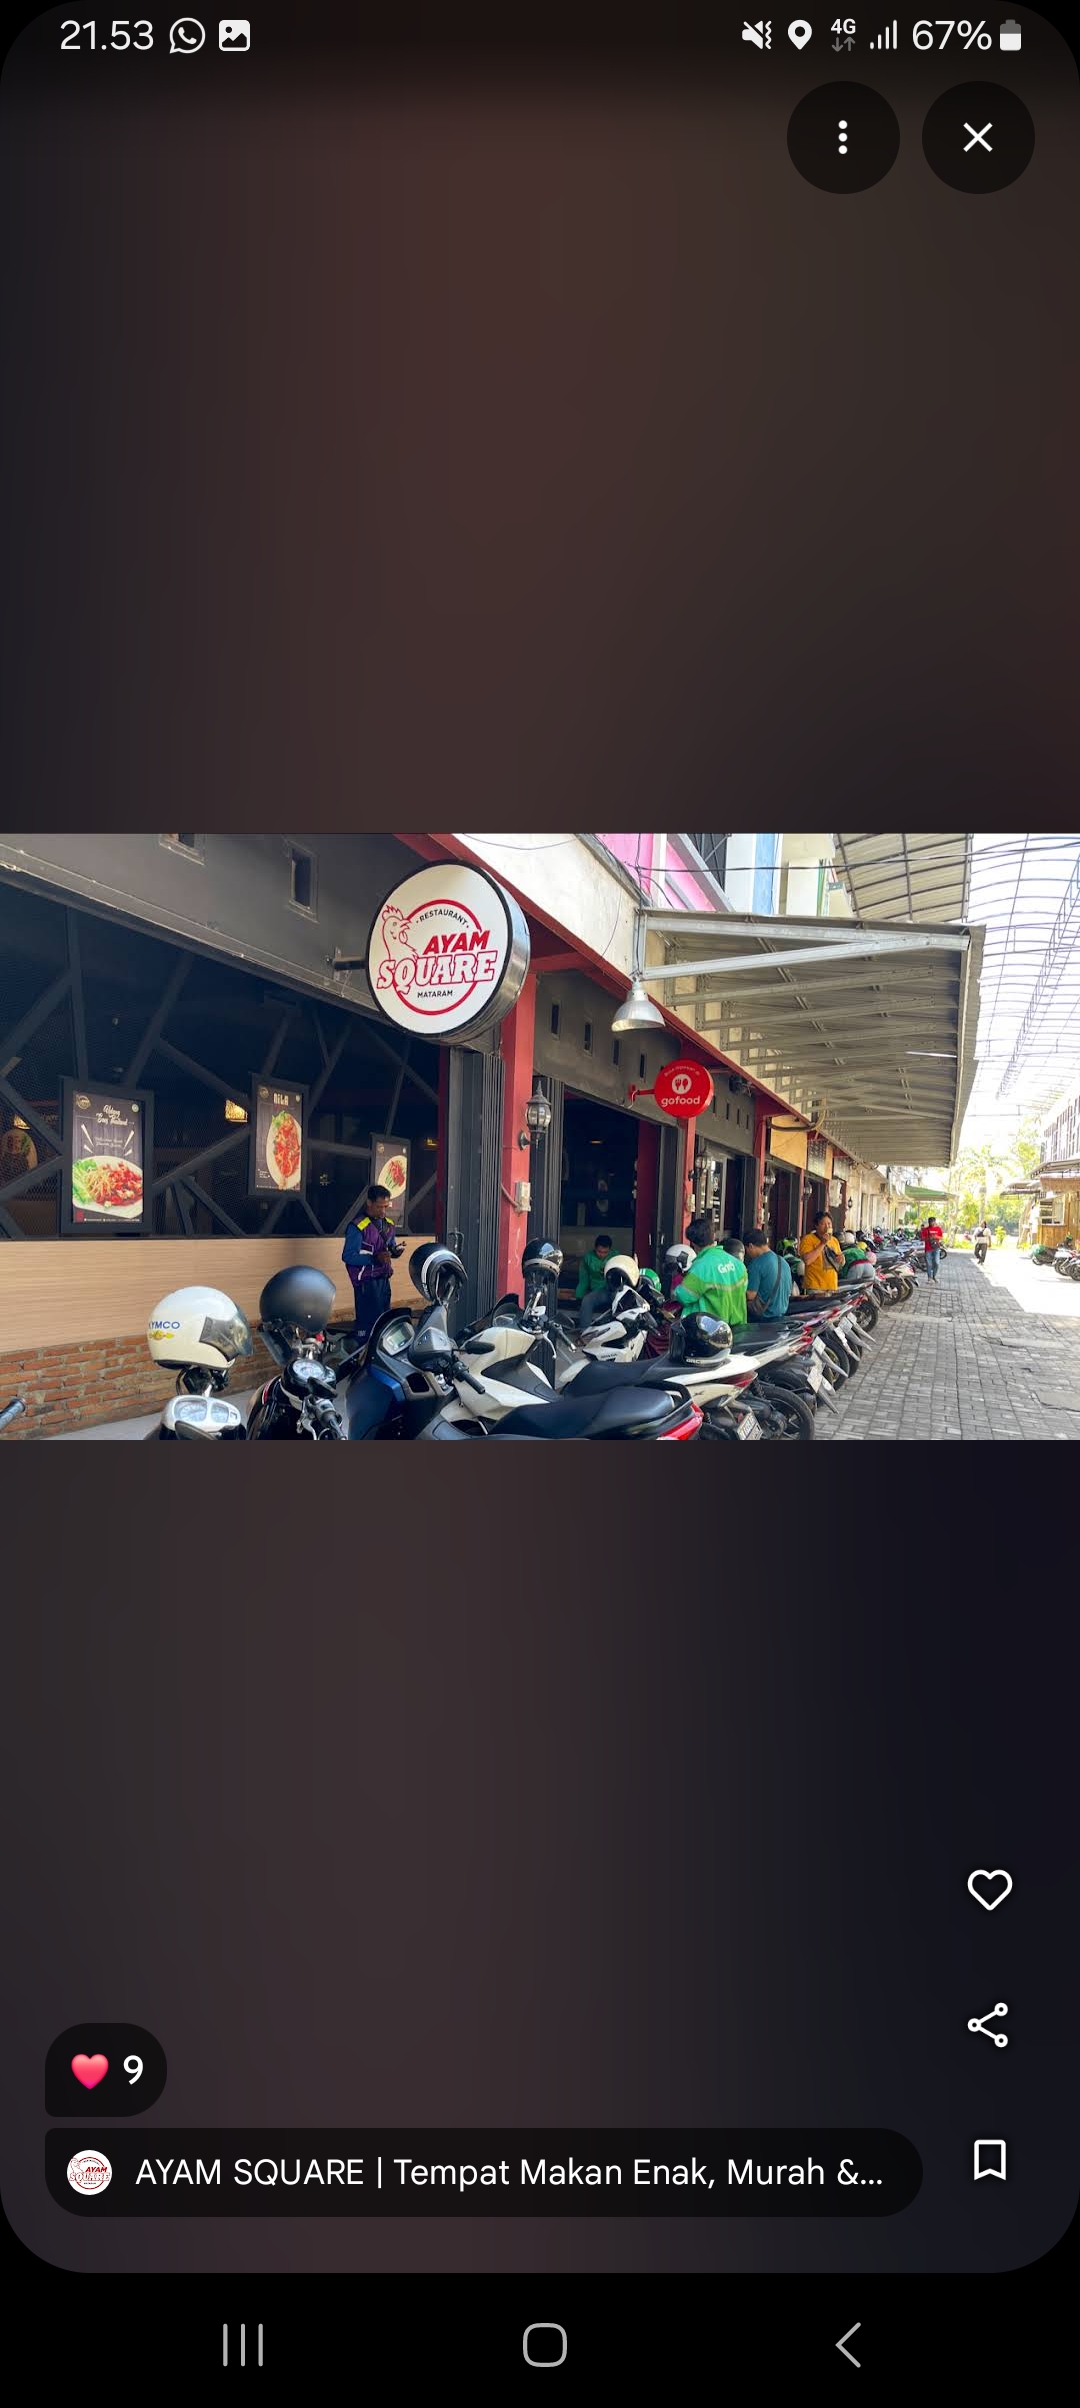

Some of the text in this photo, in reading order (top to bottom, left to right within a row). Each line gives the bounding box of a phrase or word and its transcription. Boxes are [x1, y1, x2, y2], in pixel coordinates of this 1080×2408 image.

[419, 908, 467, 926] RESTAURANT
[422, 929, 490, 955] AYAM
[376, 950, 498, 995] SQUARE
[417, 990, 453, 998] MATARAM
[661, 1095, 701, 1108] gofood
